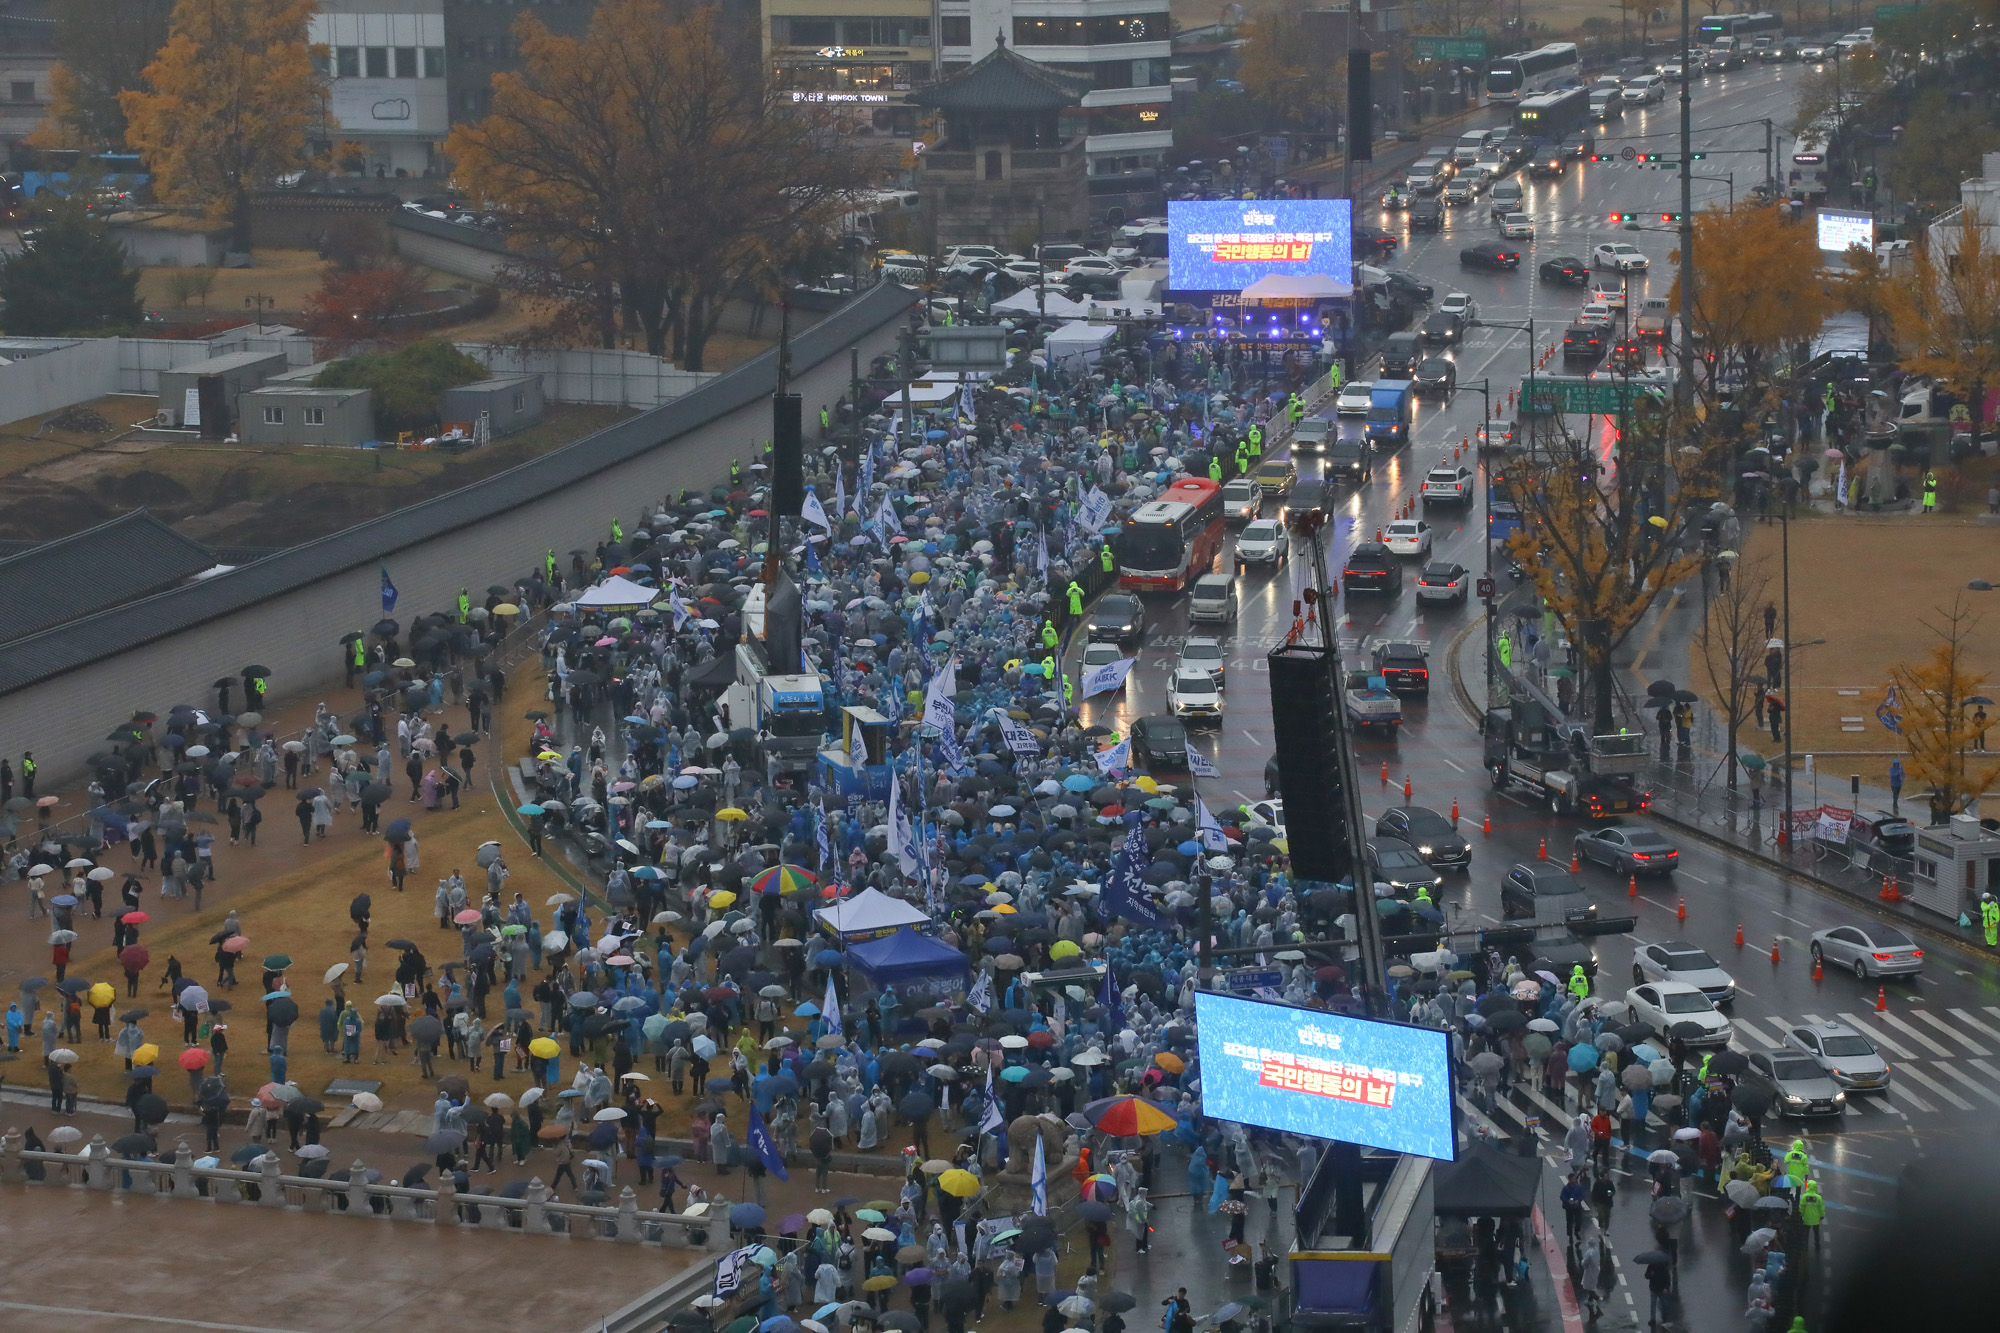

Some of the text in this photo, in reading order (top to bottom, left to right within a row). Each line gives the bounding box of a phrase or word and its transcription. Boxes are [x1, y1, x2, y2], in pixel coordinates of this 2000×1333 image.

[827, 94, 858, 102] HANBOK
[1624, 148, 1633, 157] 40
[1243, 213, 1275, 226] 민주당
[1187, 233, 1214, 244] 김건희
[1214, 232, 1240, 243] 윤석열
[1217, 243, 1312, 259] 국민행동의 날!
[1480, 584, 1491, 593] 40
[1126, 896, 1156, 921] 지역위원회
[1231, 974, 1259, 983] 세종대로
[1297, 1029, 1342, 1050] 민주당
[1223, 1041, 1259, 1060] 김건희
[1260, 1047, 1295, 1066] 윤석열
[1241, 1059, 1264, 1073] 제3차
[1263, 1063, 1395, 1105] 국민행동의 날!
